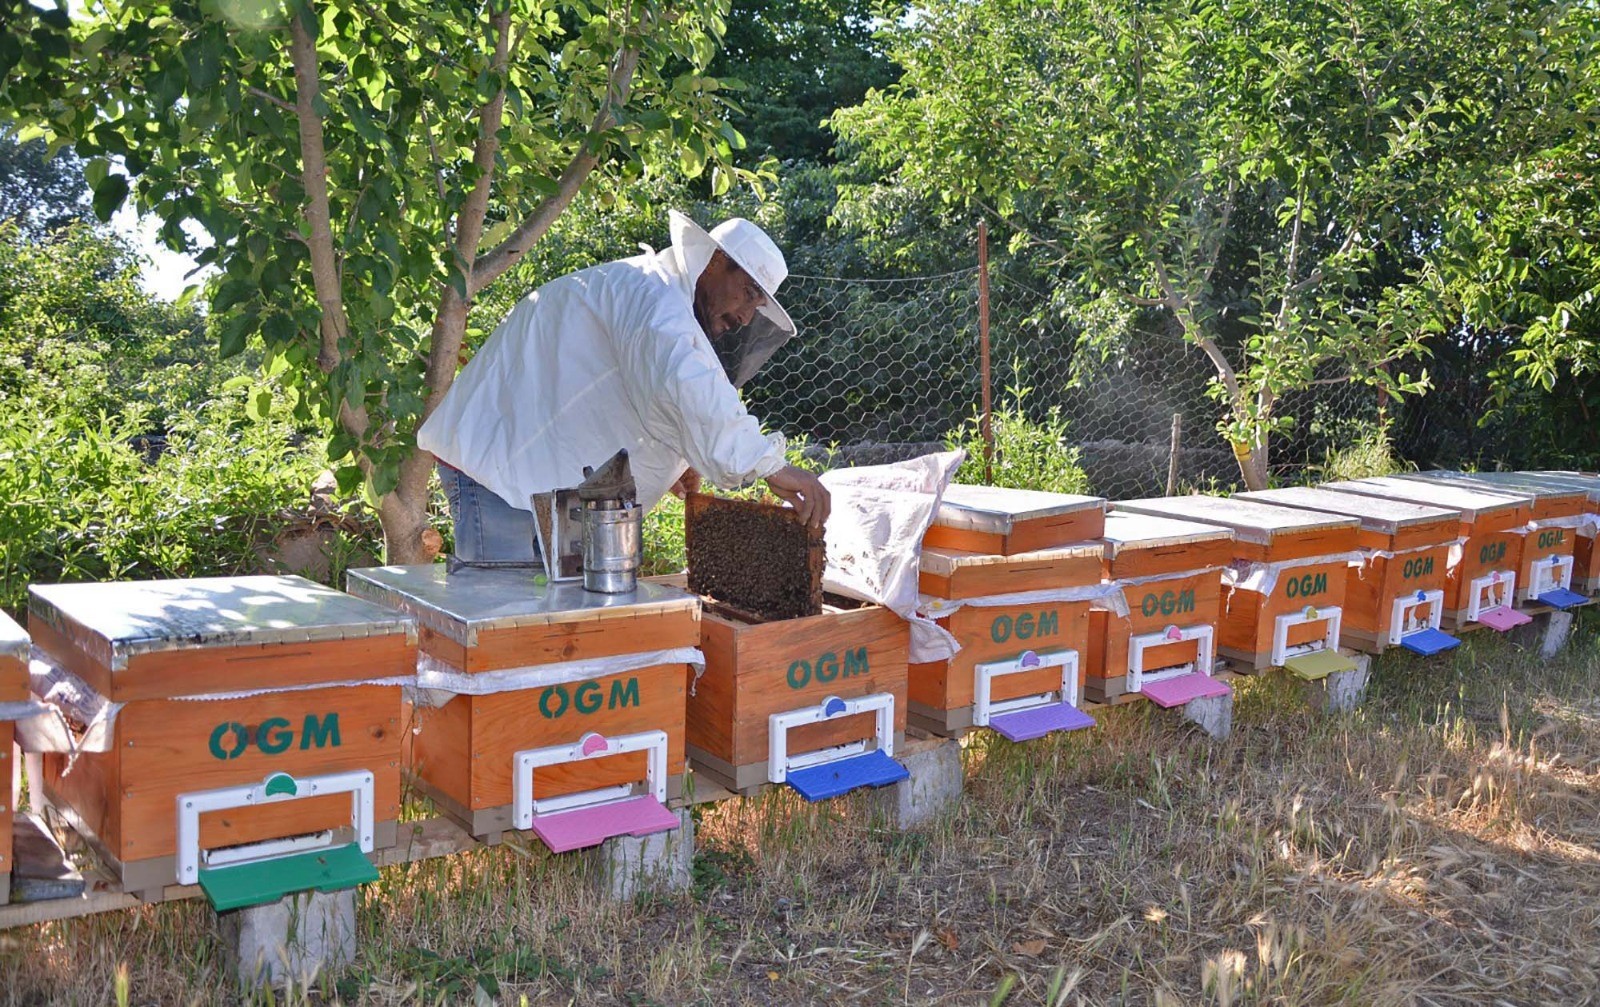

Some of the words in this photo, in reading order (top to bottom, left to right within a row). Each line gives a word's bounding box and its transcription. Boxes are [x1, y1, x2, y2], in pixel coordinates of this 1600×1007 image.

[1480, 541, 1506, 564] OGM
[1404, 557, 1433, 579] OGM
[1287, 573, 1327, 598] OGM
[1142, 589, 1195, 617] OGM
[991, 611, 1058, 643] OGM
[786, 647, 869, 690] OGM
[539, 677, 640, 719] OGM
[209, 713, 342, 760] OGM
